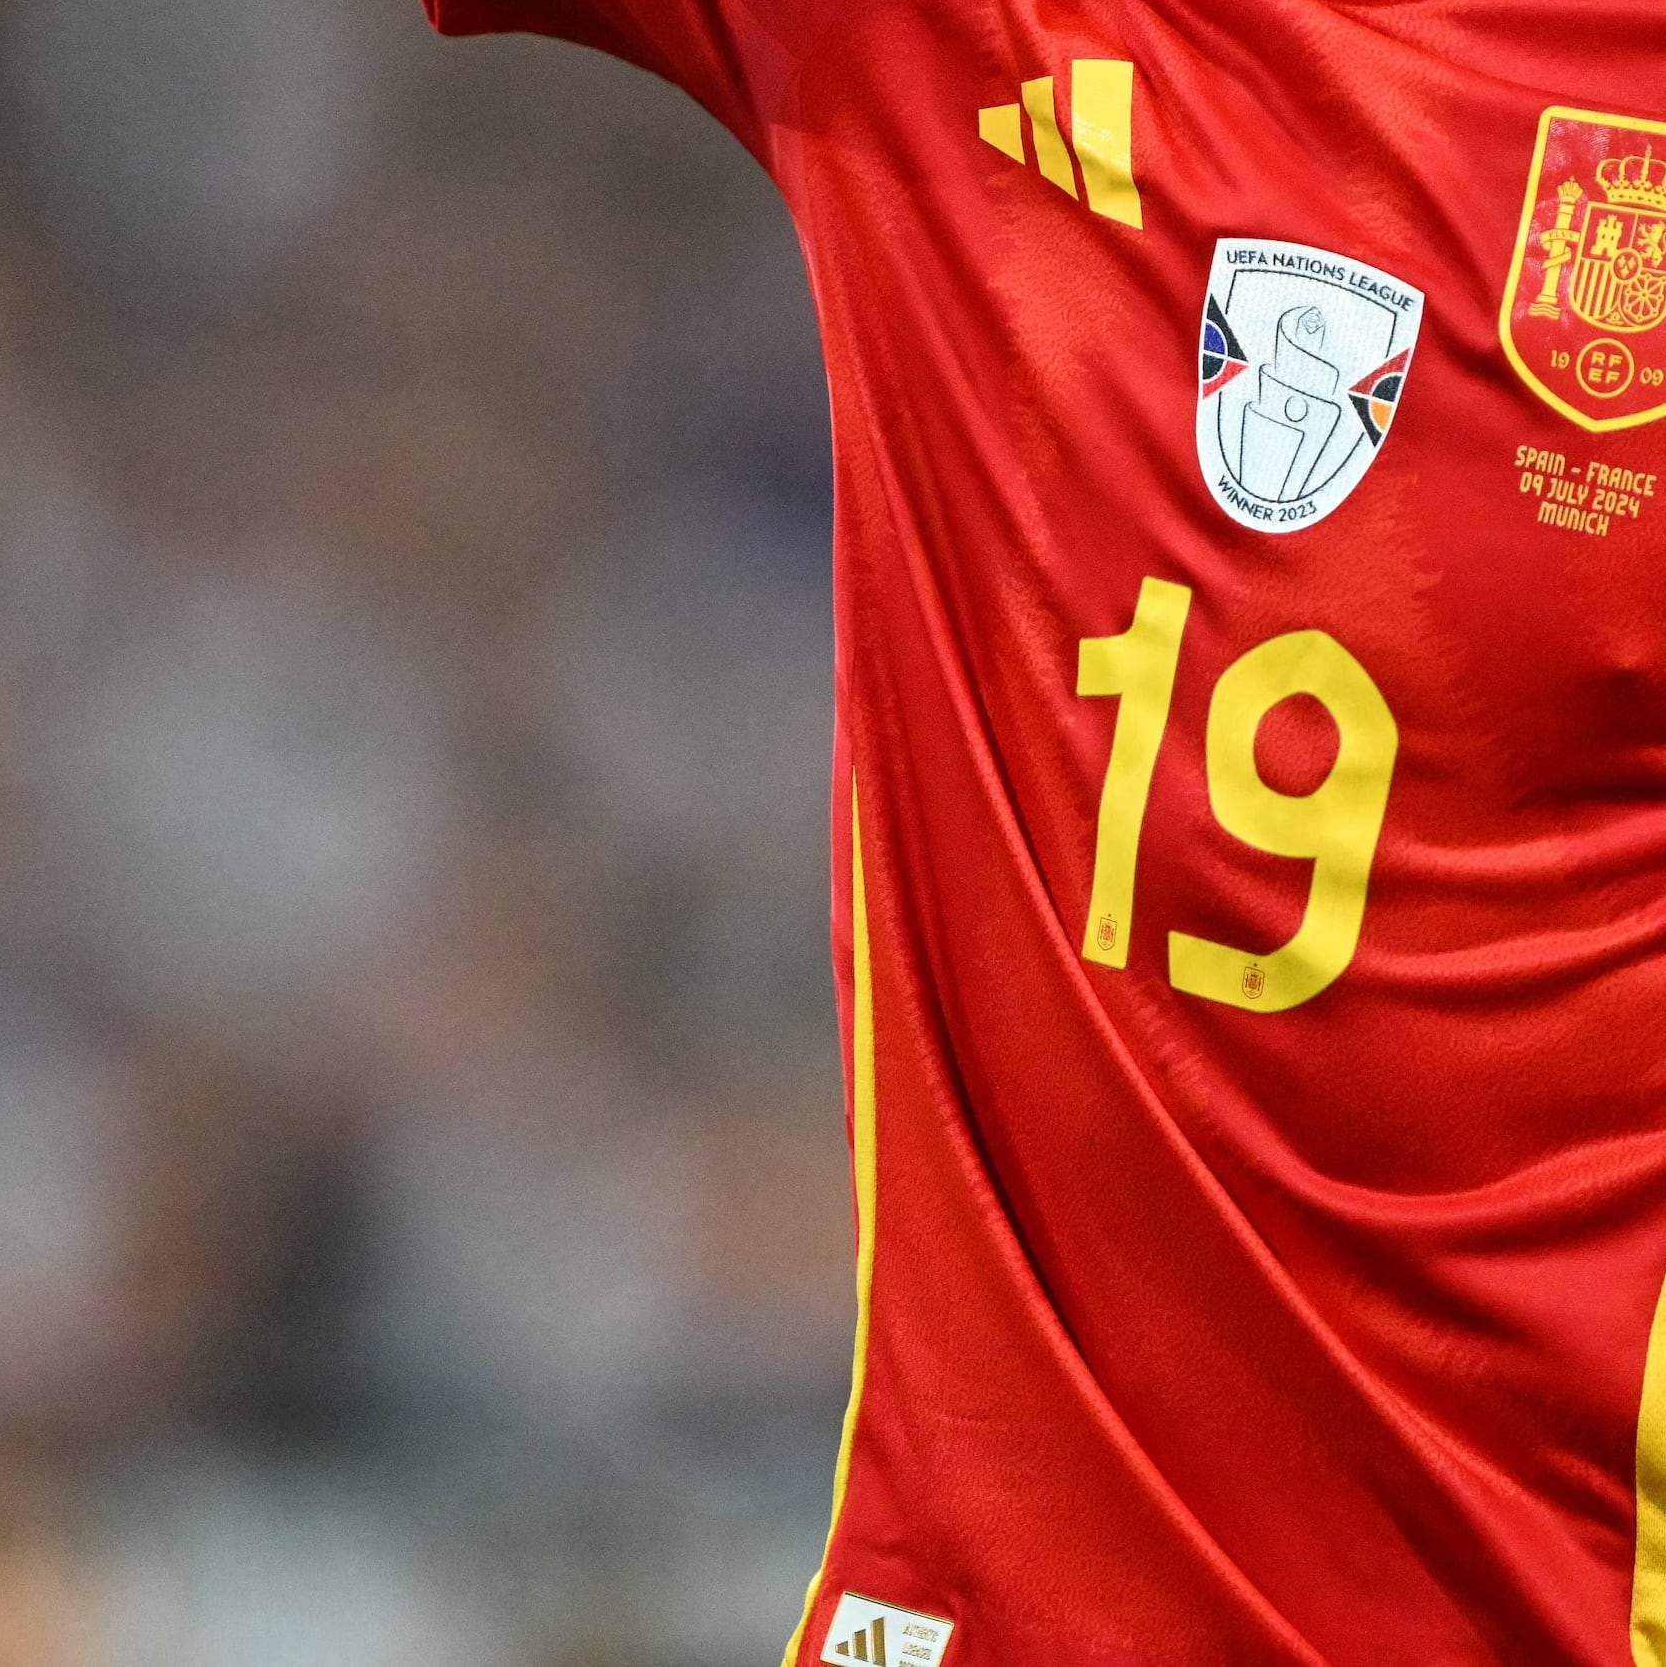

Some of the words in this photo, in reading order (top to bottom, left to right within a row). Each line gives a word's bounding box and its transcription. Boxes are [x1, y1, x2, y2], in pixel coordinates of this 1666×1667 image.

[1226, 249, 1268, 265] UEFA
[1272, 253, 1346, 281] NATIONS
[1348, 271, 1415, 312] LEAGUE
[1550, 349, 1570, 370] 19
[1639, 366, 1665, 387] 09
[1514, 444, 1566, 477] SPAIN
[1586, 461, 1658, 497] FRANCE
[1217, 474, 1274, 521] WINNER
[1278, 499, 1317, 522] 2023
[1519, 471, 1544, 497] 09
[1546, 477, 1590, 506] JULY
[1591, 488, 1641, 519] 2024
[1537, 501, 1611, 537] MUNICH
[1076, 575, 1400, 1014] 19
